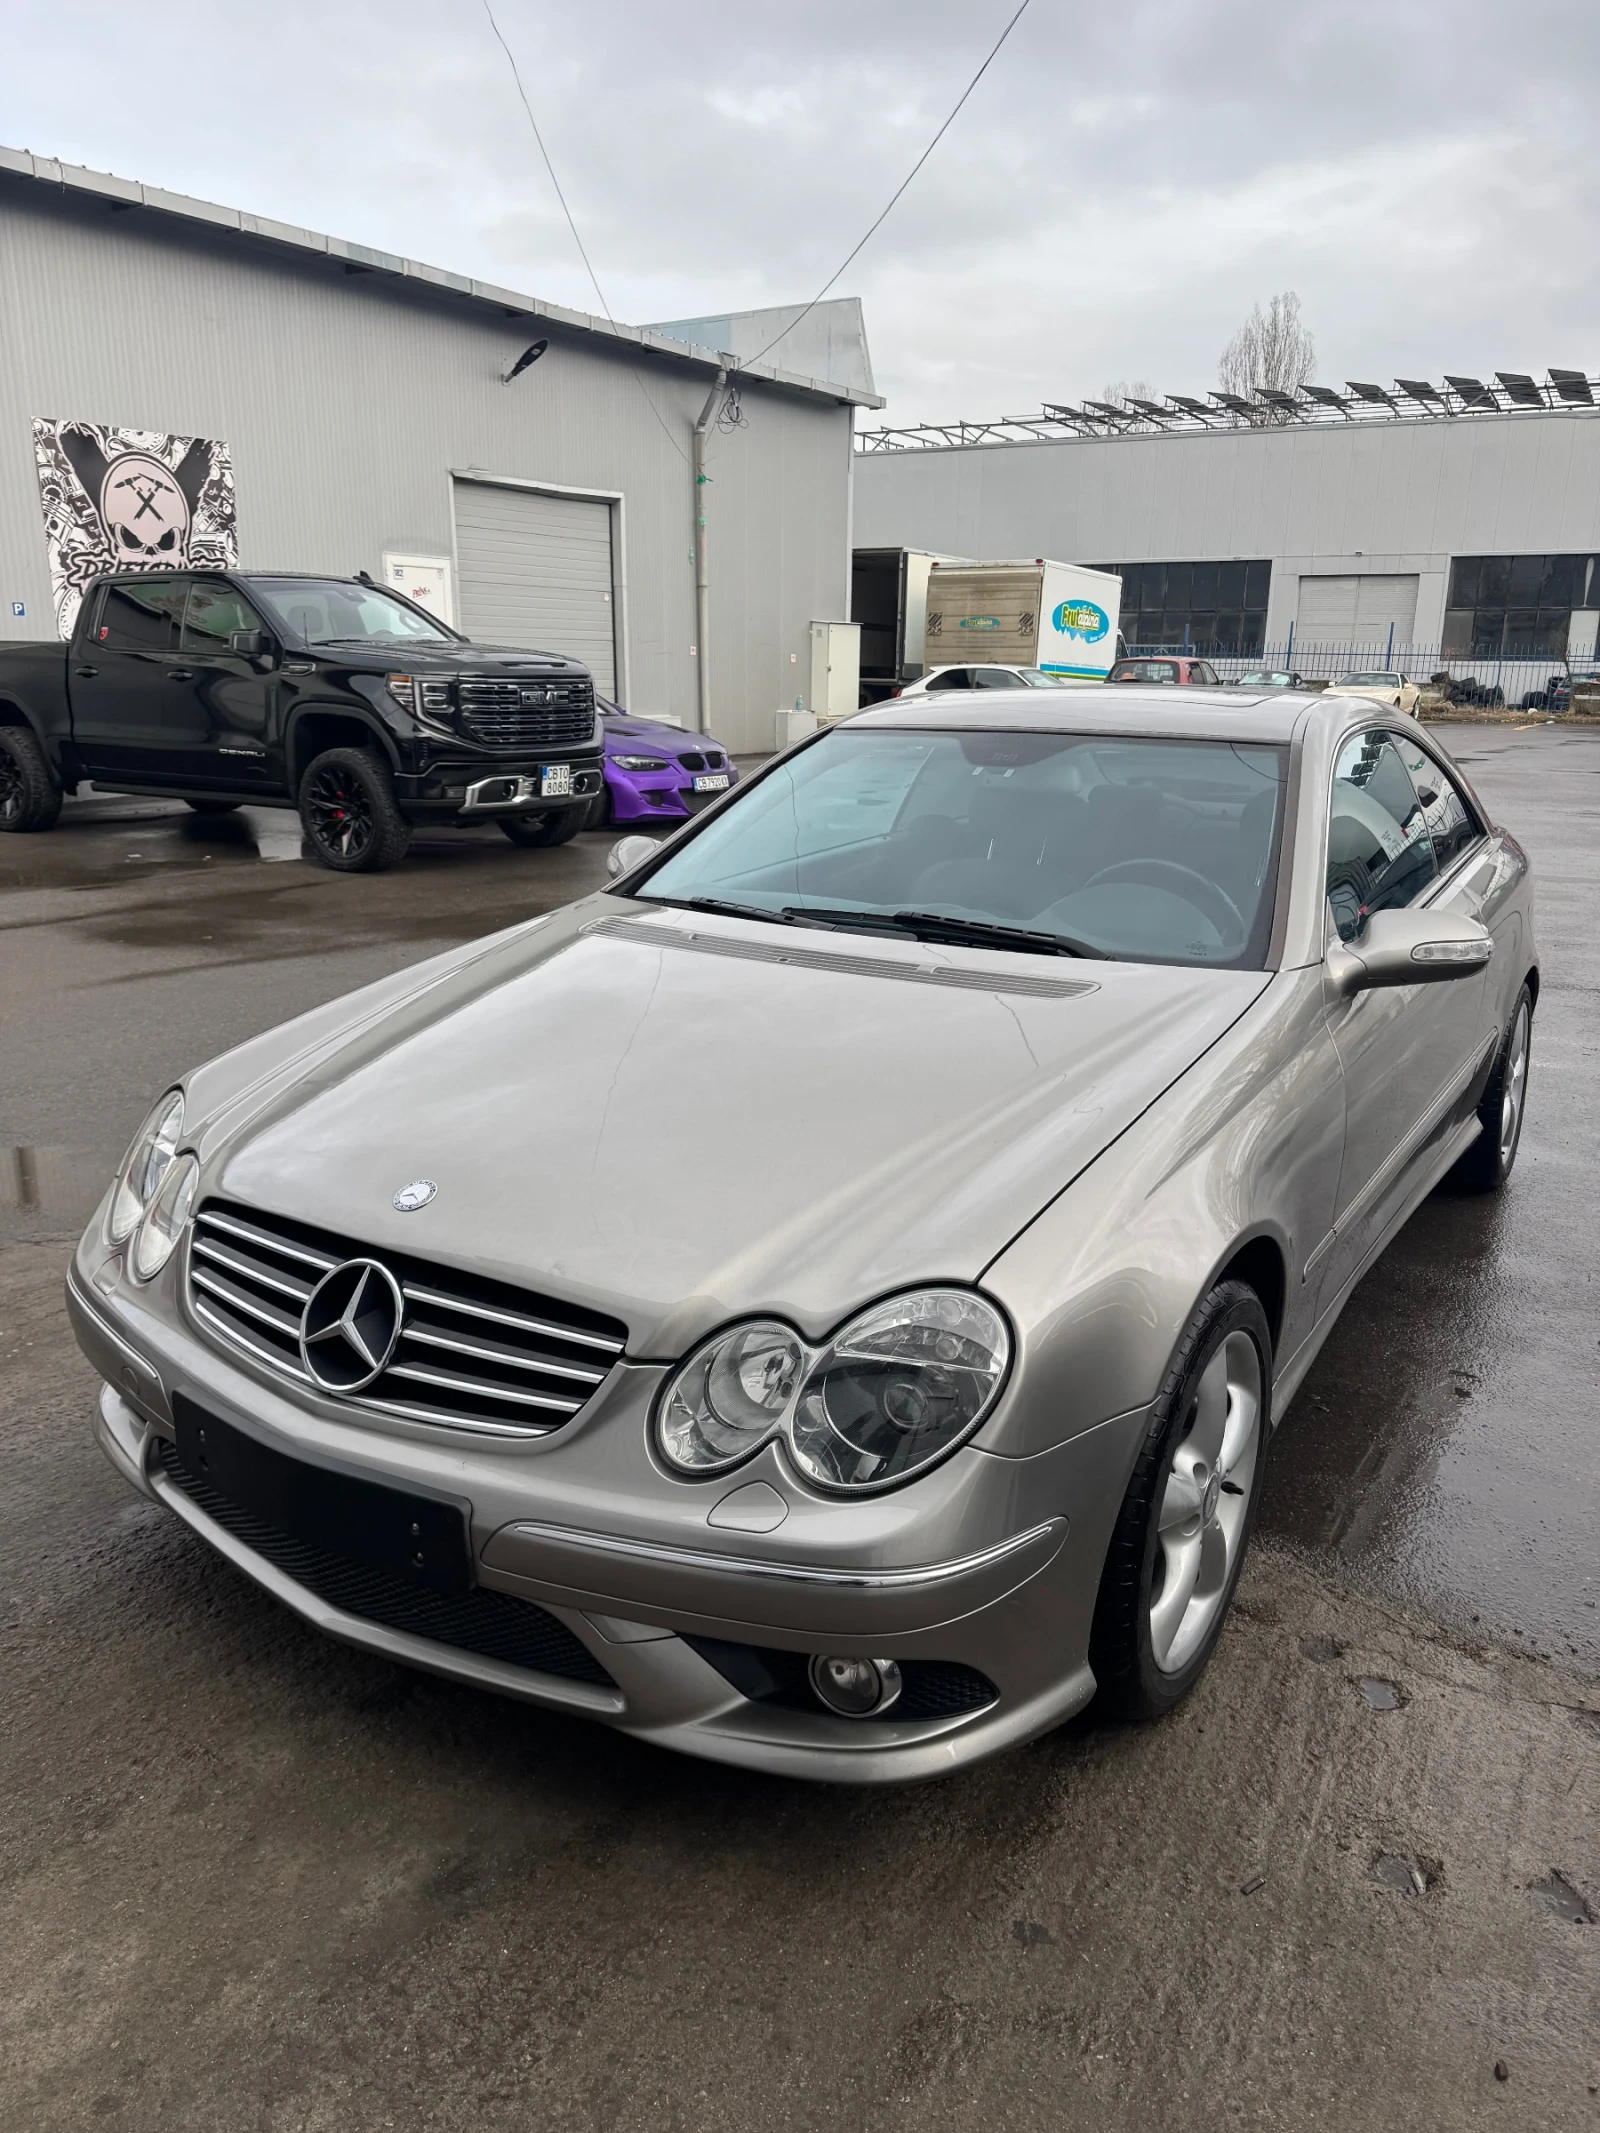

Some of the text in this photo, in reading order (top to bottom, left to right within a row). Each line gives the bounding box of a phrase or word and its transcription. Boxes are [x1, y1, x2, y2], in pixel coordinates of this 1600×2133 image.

[13, 603, 23, 615] P
[521, 691, 569, 705] GMC
[219, 748, 266, 757] DENALI
[547, 781, 567, 793] 8080
